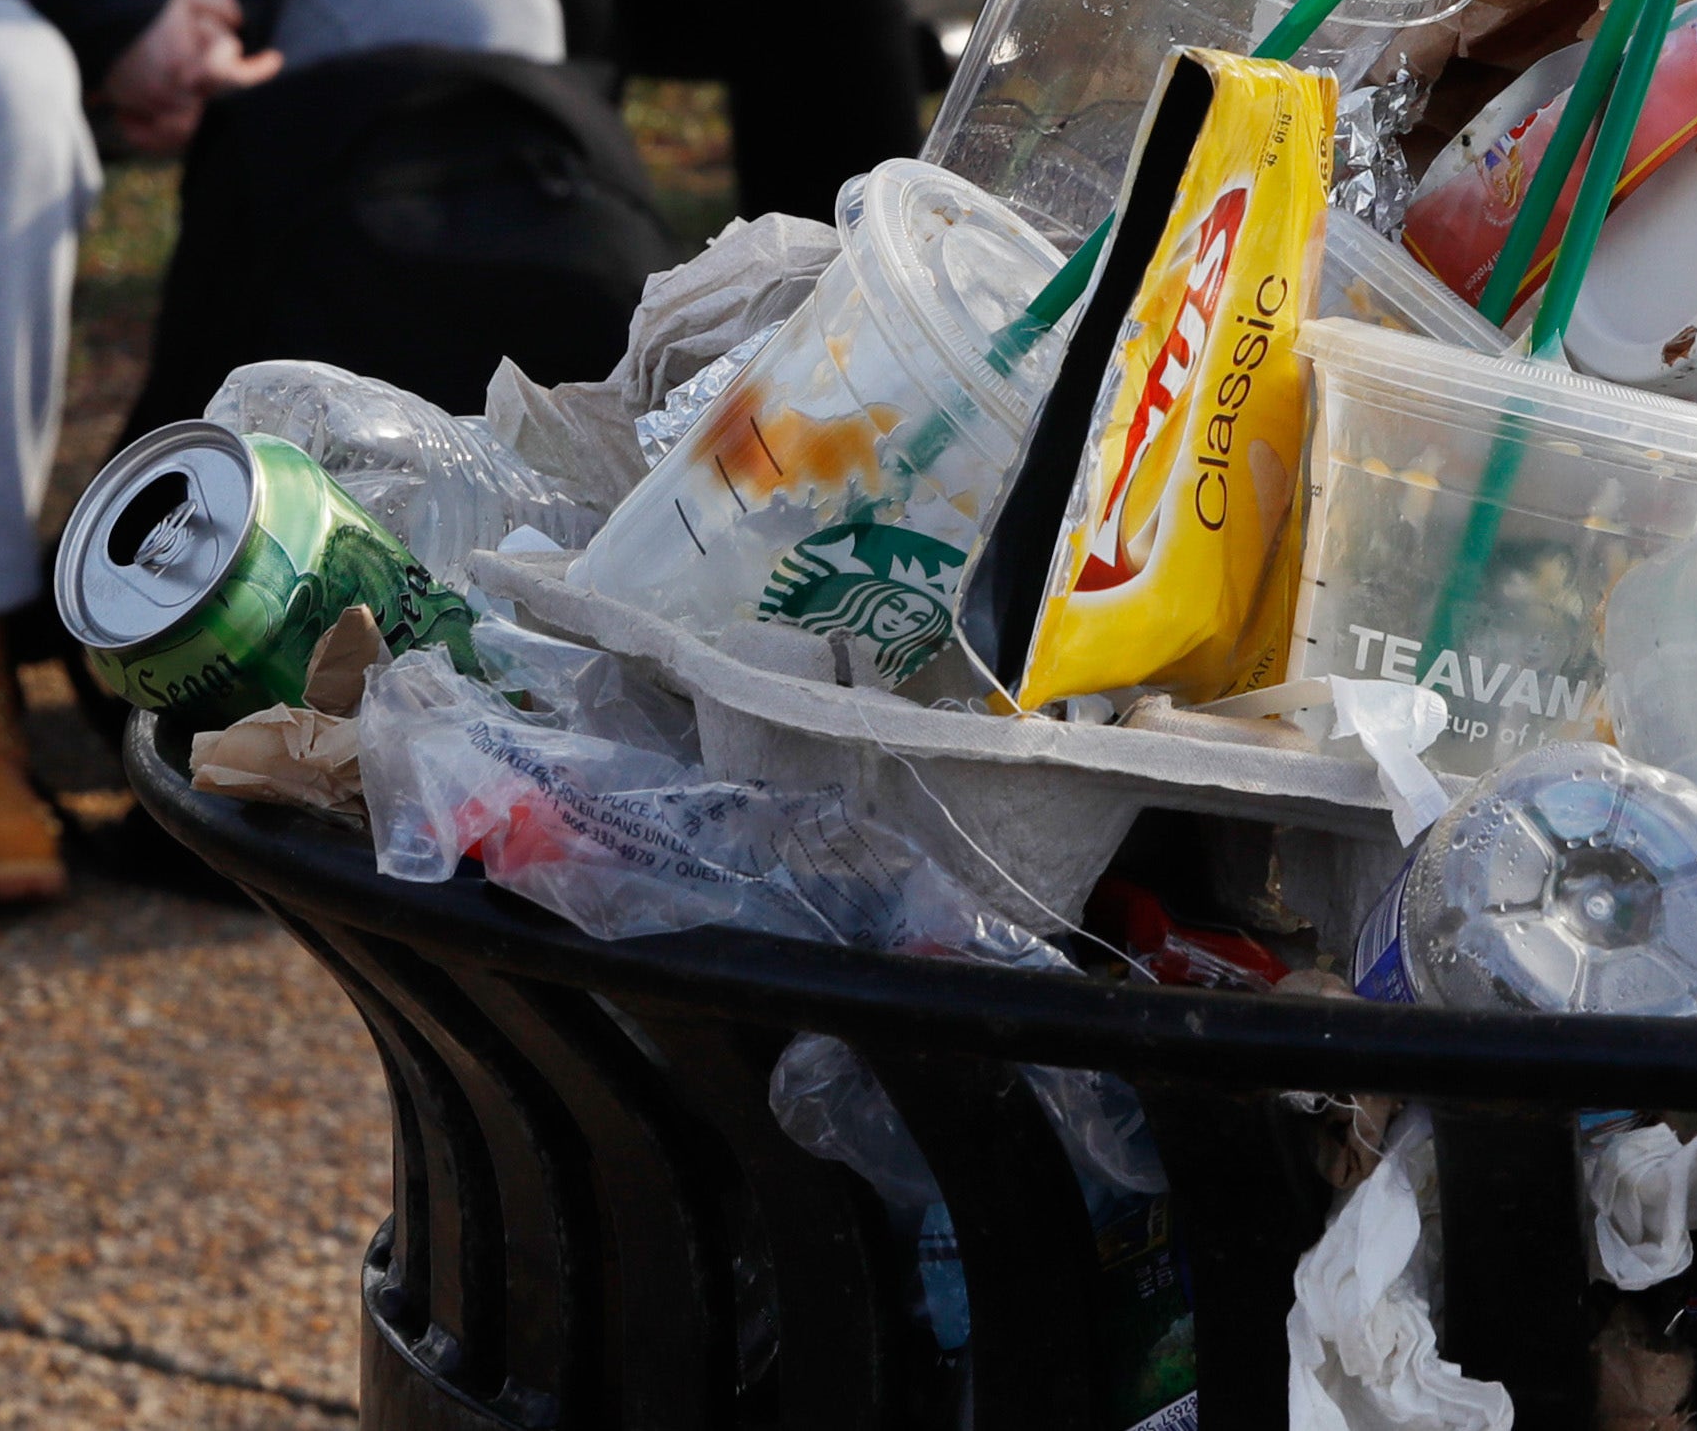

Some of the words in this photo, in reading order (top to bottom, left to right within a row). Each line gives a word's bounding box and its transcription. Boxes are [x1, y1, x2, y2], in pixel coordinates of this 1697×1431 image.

[1196, 273, 1288, 532] Classic
[466, 721, 494, 755] STORE
[1500, 724, 1531, 747] of
[601, 811, 641, 838] DANS
[645, 828, 667, 848] UN
